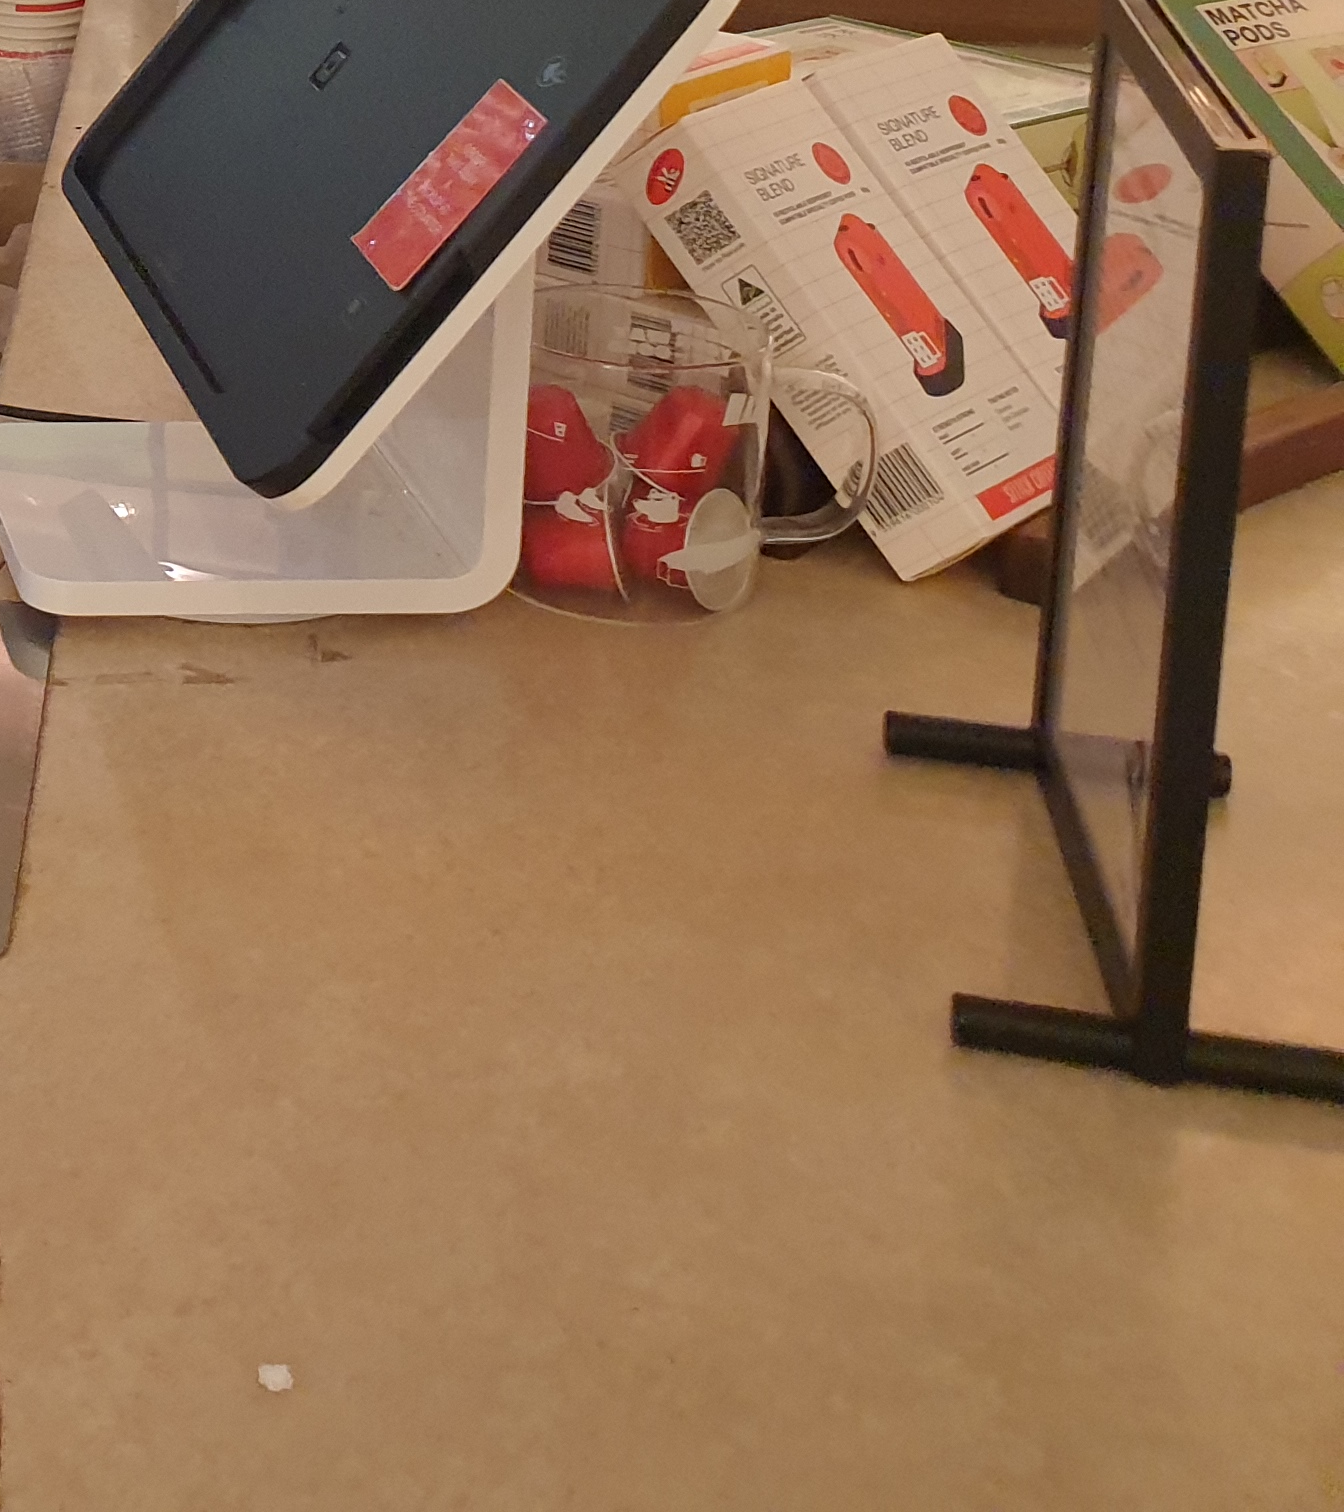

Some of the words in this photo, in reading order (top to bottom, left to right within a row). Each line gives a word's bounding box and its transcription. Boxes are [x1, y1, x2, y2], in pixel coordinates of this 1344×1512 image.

[1223, 21, 1291, 47] PODS
[876, 105, 942, 137] SIGNATURE
[888, 128, 929, 152] BLEND
[743, 152, 806, 186] SIGNATURE
[755, 177, 796, 203] BLEND
